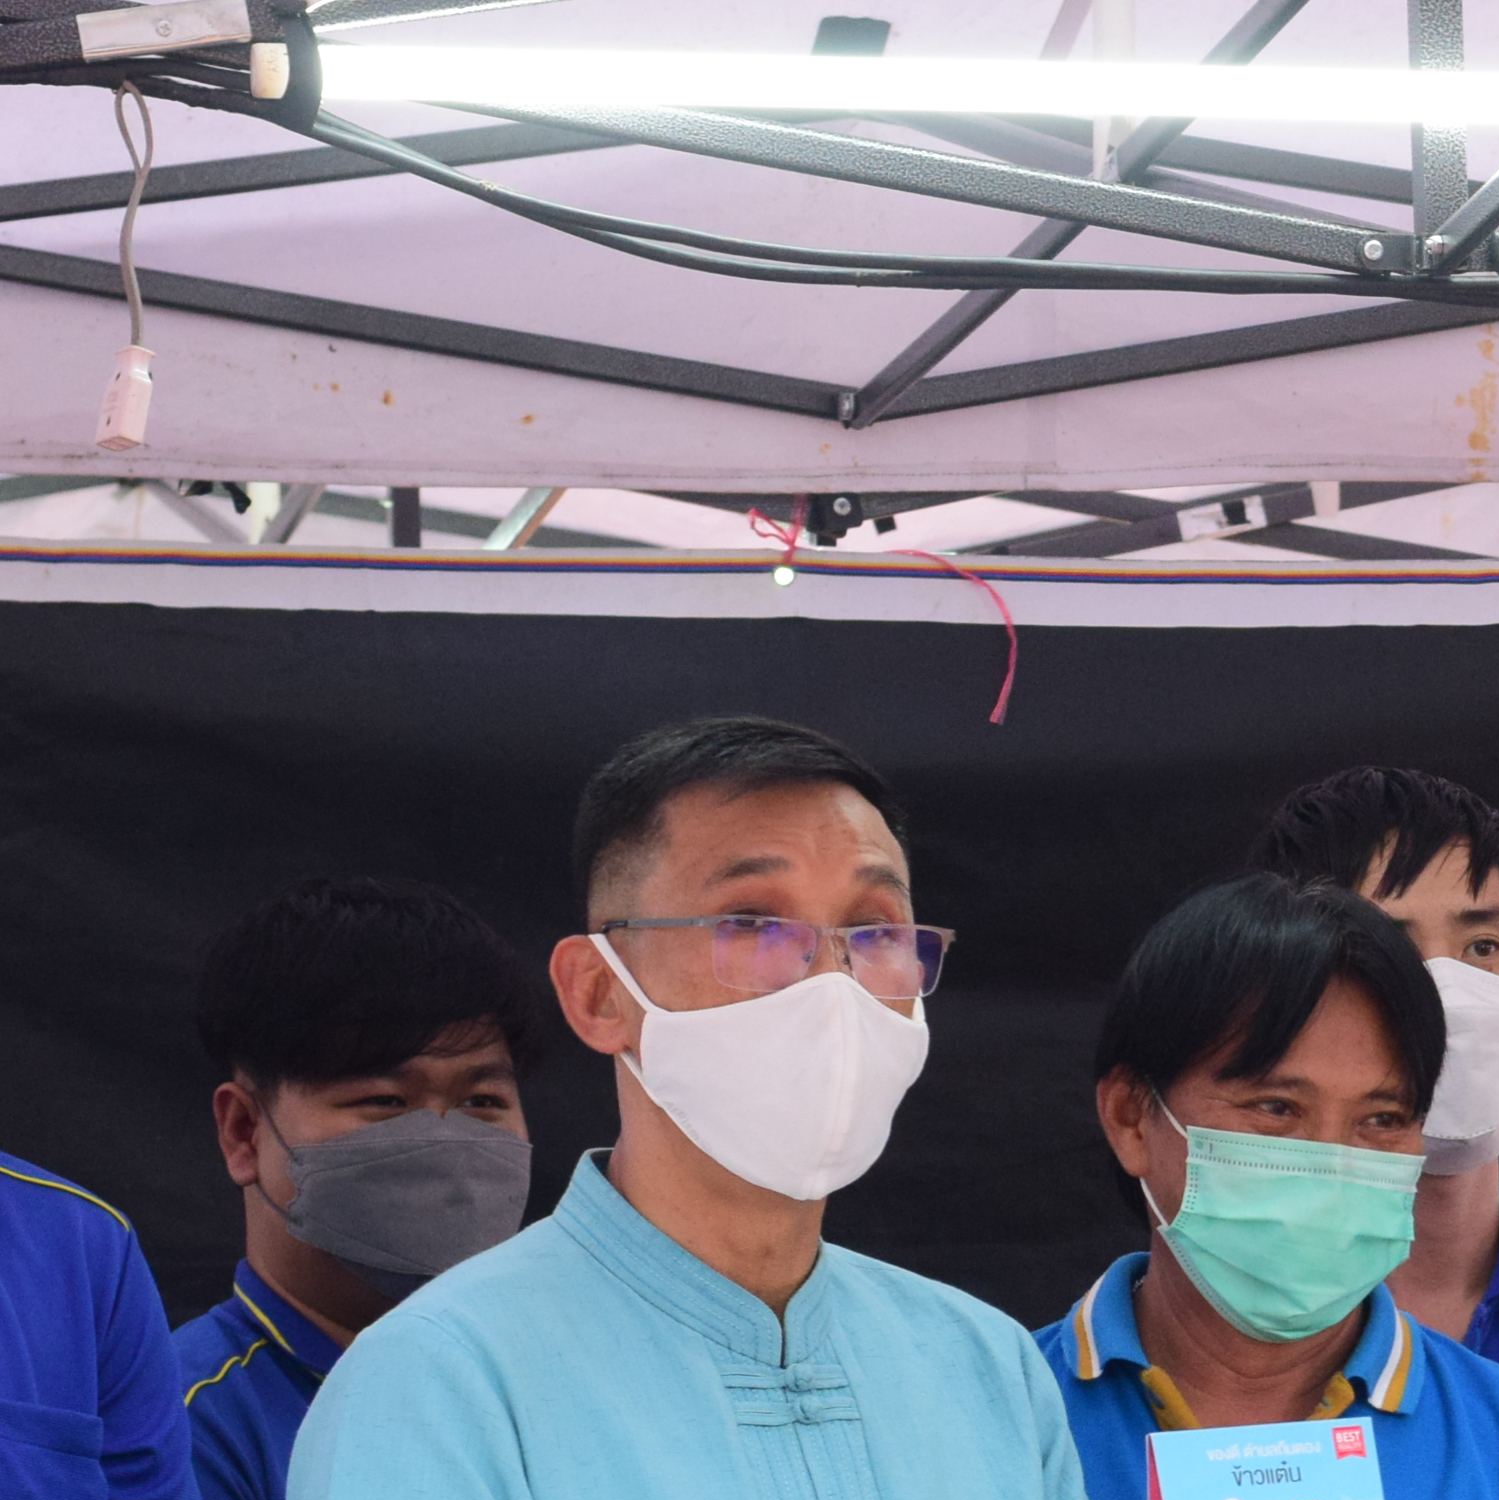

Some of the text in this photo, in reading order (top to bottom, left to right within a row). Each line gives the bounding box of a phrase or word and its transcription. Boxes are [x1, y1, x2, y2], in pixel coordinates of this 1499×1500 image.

[1335, 1431, 1361, 1443] BEST
[1231, 1460, 1302, 1486] ข้าวแต๋น
